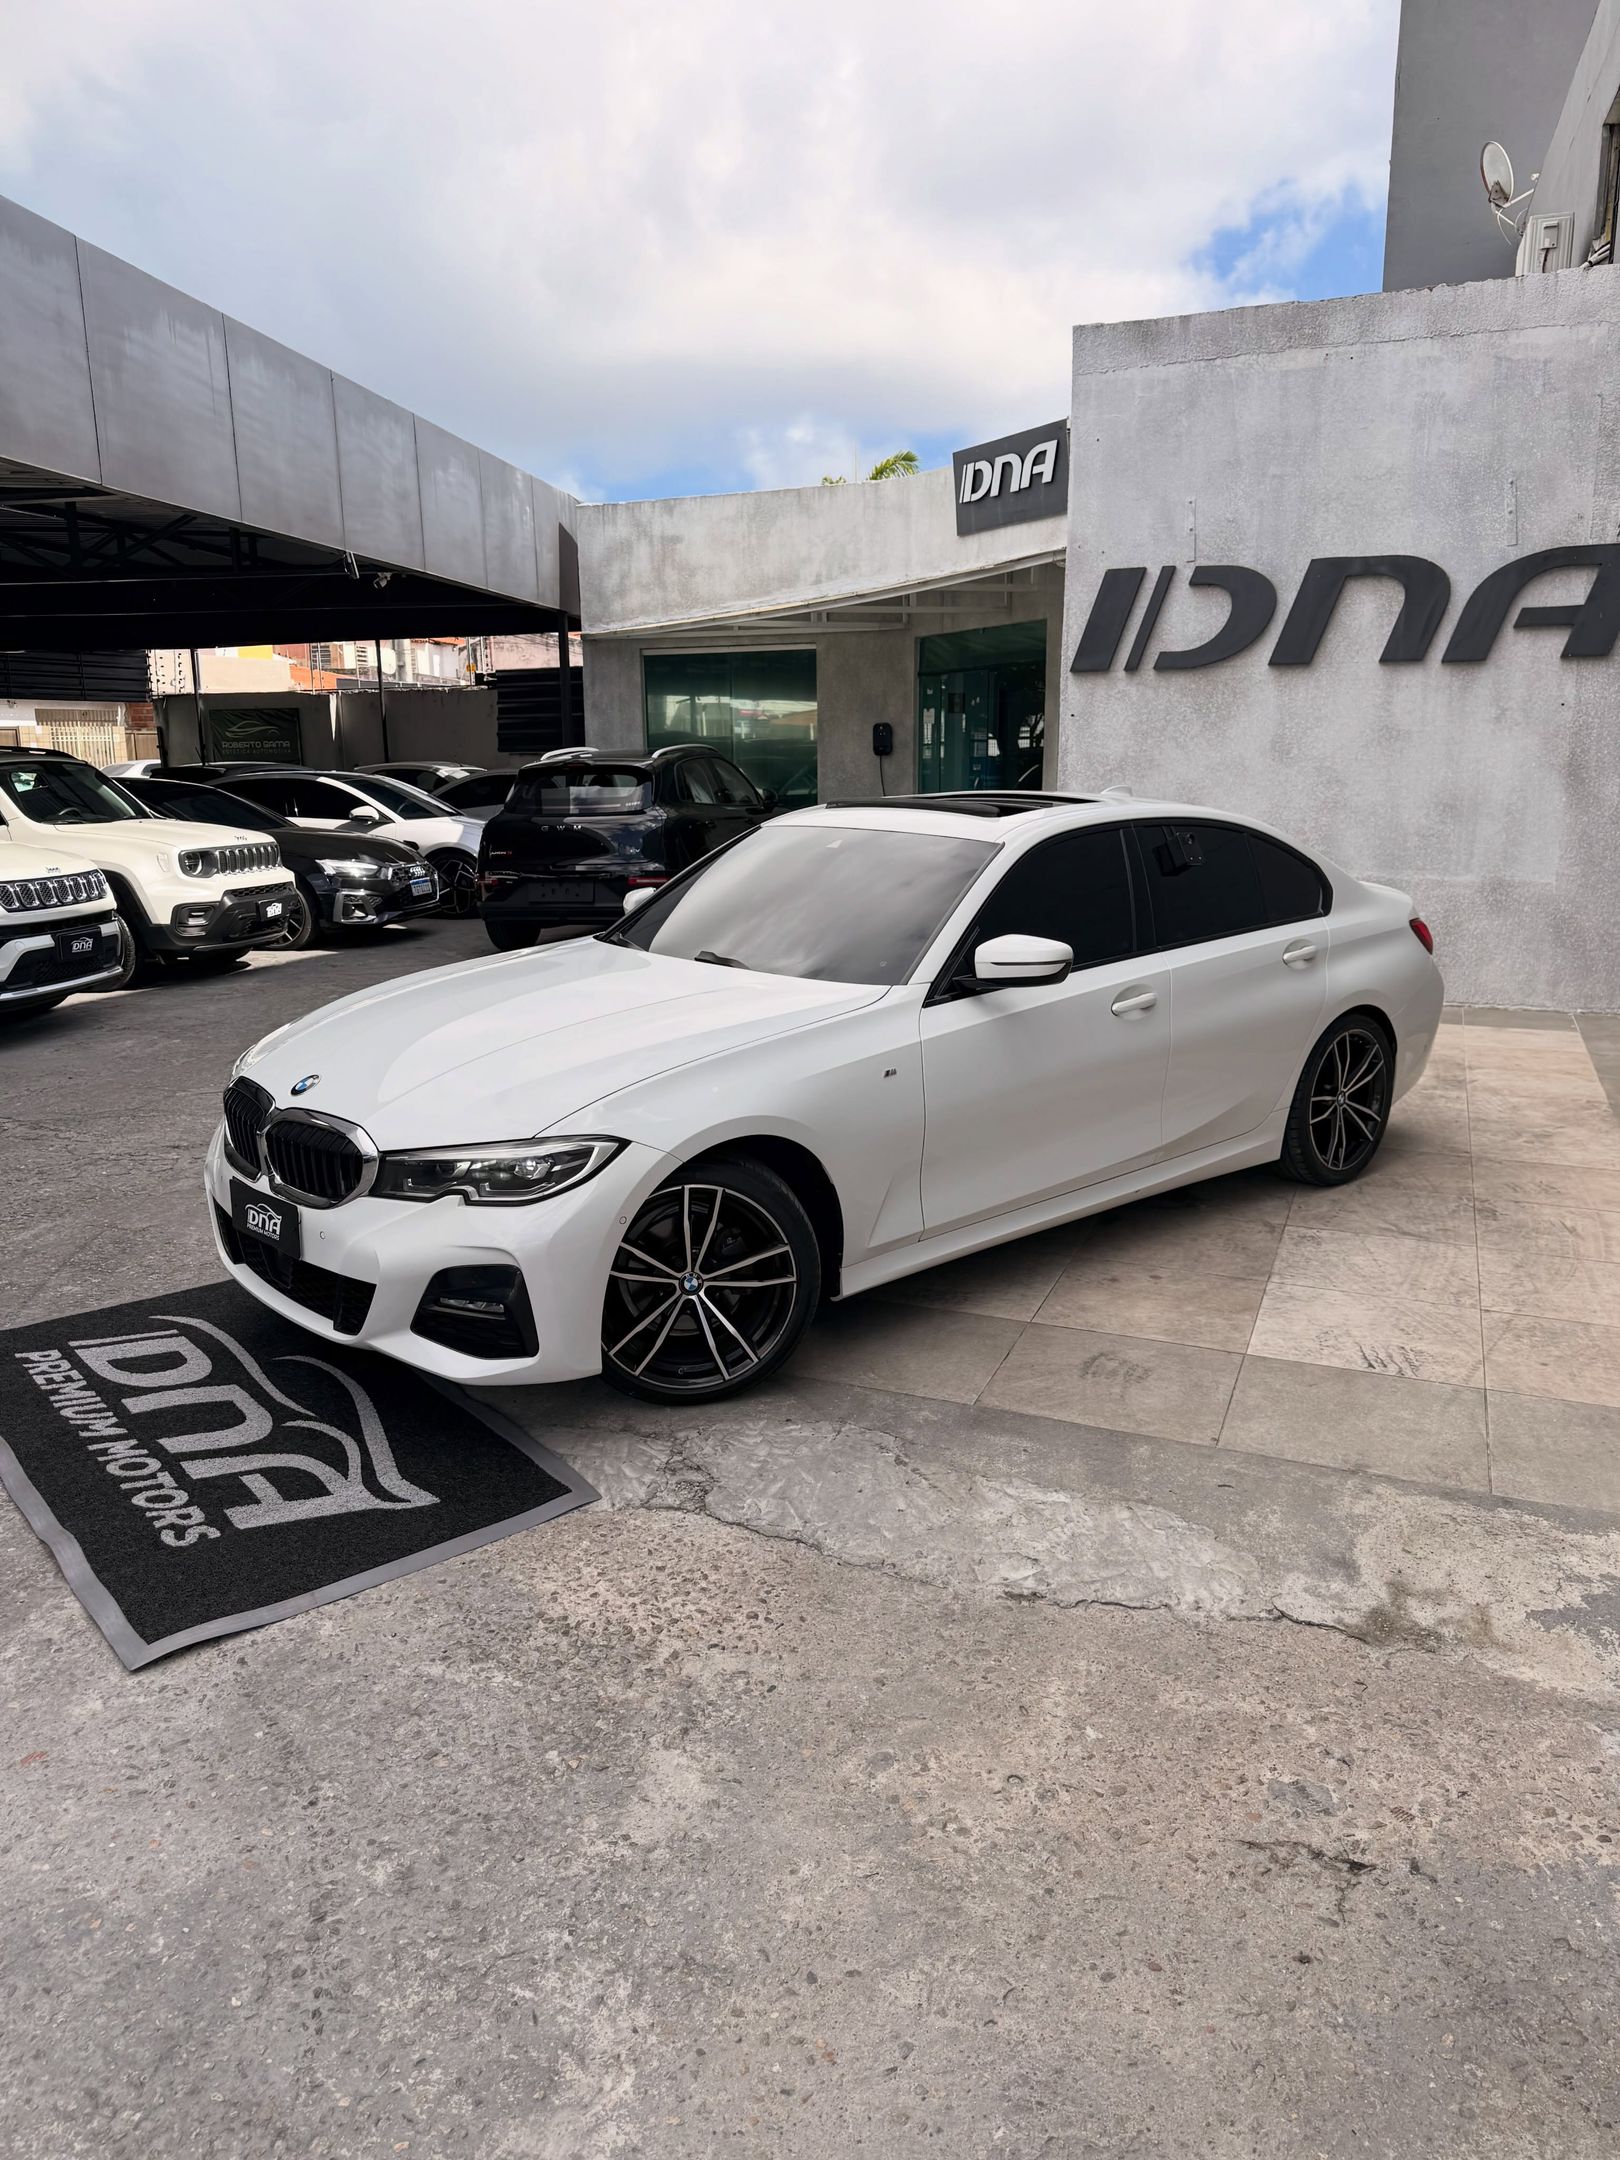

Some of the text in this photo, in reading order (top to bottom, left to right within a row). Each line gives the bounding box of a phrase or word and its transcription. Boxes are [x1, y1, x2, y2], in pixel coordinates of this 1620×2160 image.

[960, 439, 1058, 504] DNA
[222, 741, 262, 749] ROBERTO
[247, 1222, 280, 1241] PREMIUM MOTORS
[15, 1348, 221, 1548] PREMIUM MOTORS
